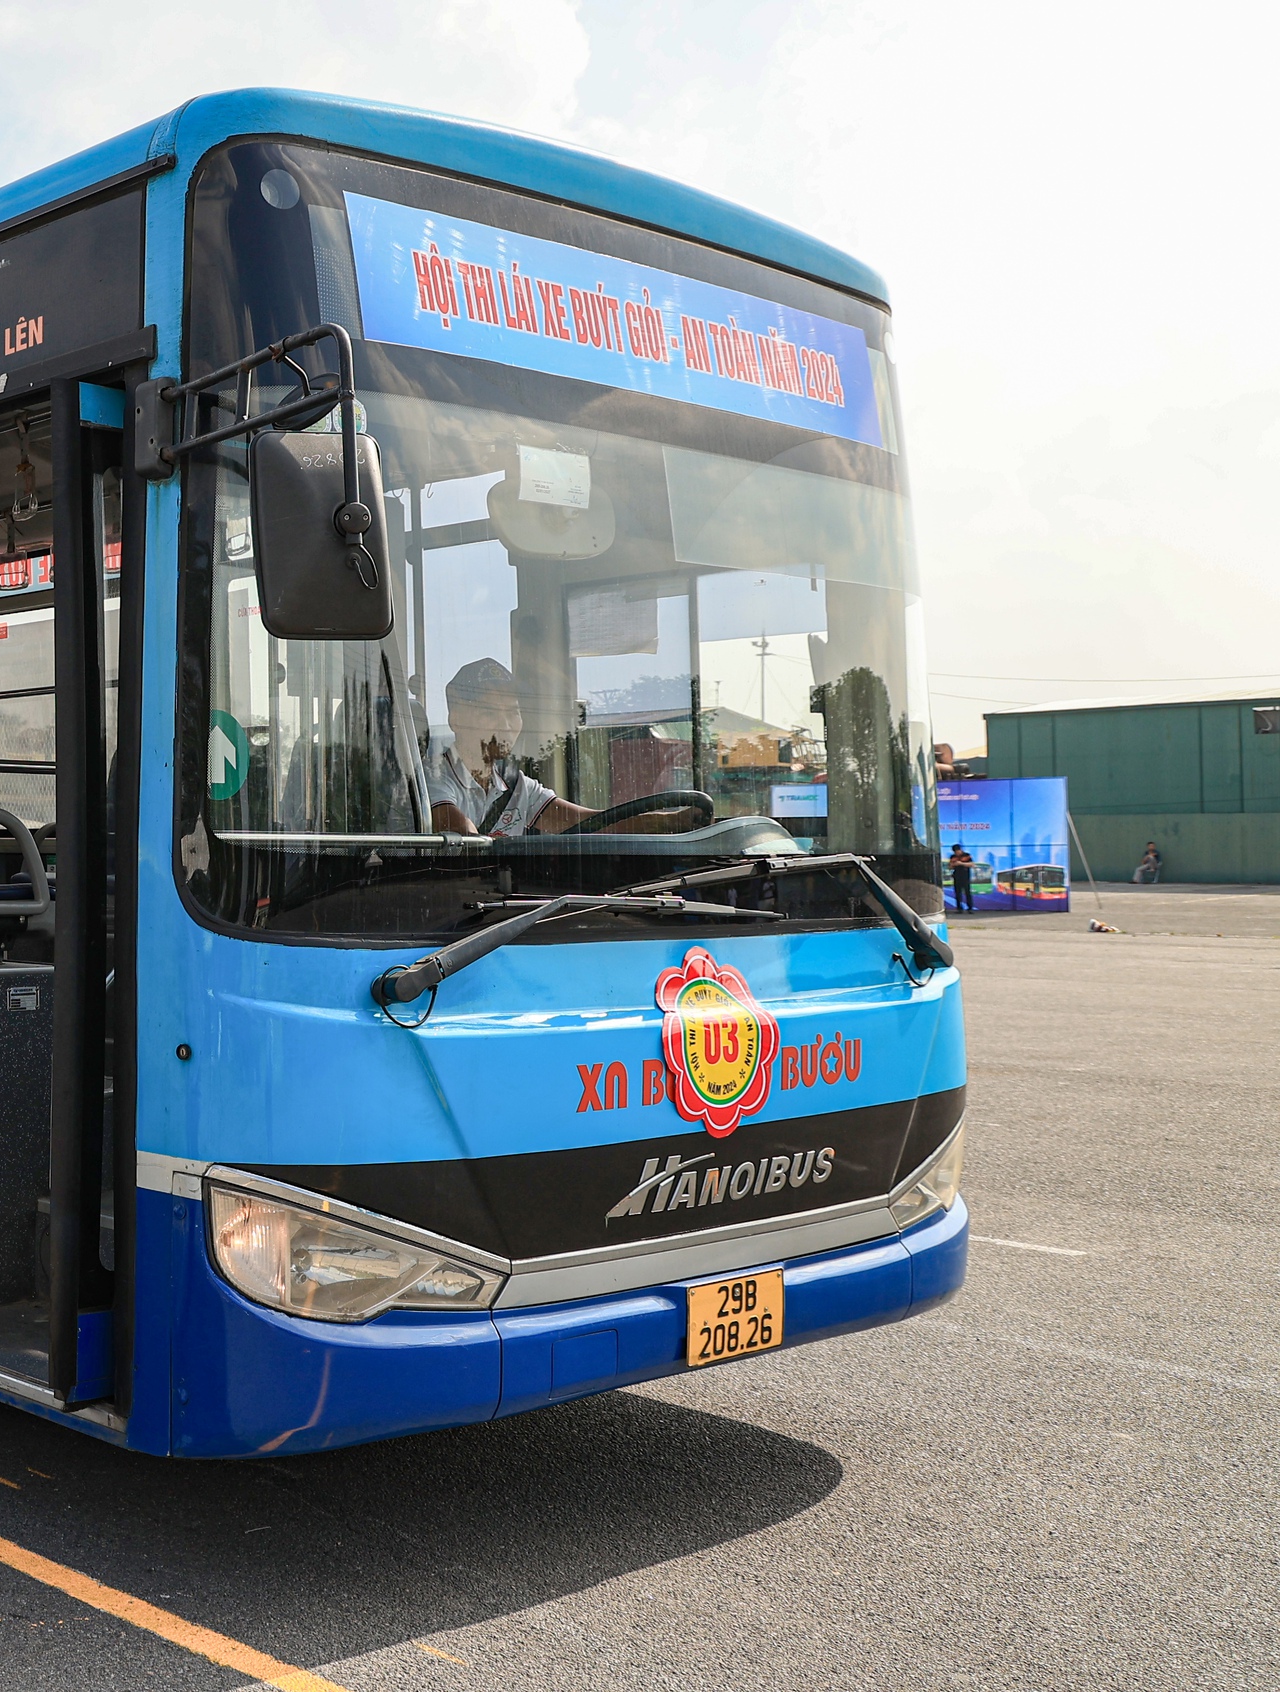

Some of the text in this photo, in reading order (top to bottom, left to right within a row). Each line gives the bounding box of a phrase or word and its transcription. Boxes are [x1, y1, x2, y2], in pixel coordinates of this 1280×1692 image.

[4, 316, 44, 356] LÊN
[411, 241, 845, 408] HỘI THI LÁI XE BUÝT GIỎI - AN TOÀN NĂM 2024
[703, 1014, 740, 1065] 03
[605, 1147, 836, 1219] HANOIBUS
[717, 1280, 757, 1318] 29B
[699, 1313, 772, 1360] 208.26
